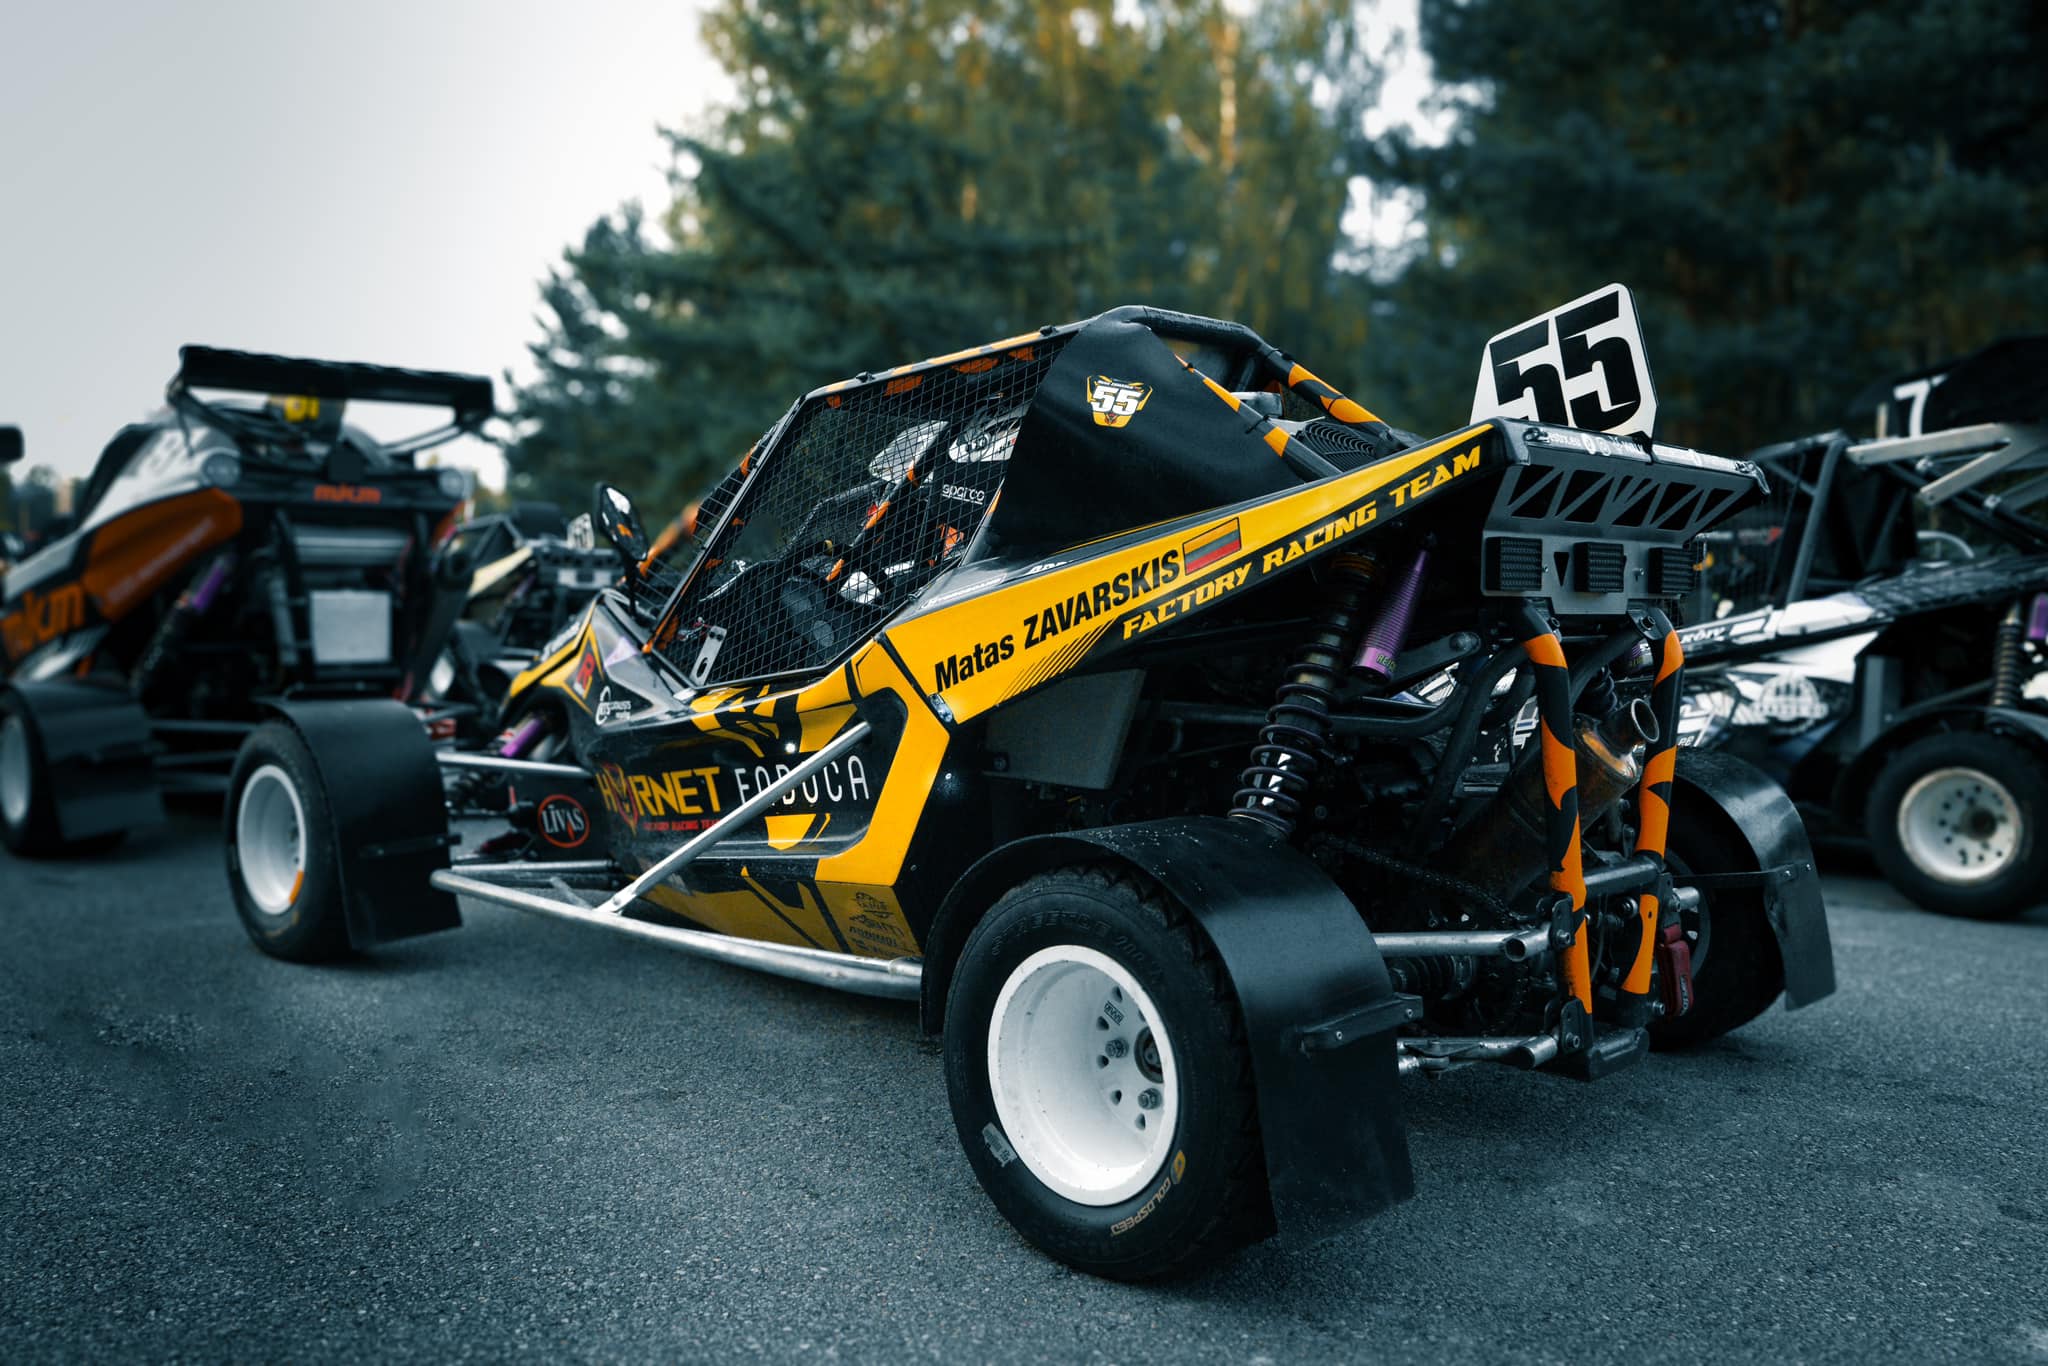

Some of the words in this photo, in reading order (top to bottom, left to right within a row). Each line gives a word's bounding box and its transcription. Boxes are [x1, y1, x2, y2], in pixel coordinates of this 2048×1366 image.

[1090, 386, 1143, 416] 55
[1489, 290, 1641, 432] 55
[942, 484, 985, 504] sparco
[1122, 563, 1252, 641] FACTORY
[1262, 500, 1377, 574] RACING
[1389, 445, 1481, 508] TEAM
[933, 634, 1015, 693] Matas
[1023, 549, 1180, 650] ZAVARSKIS
[1110, 1177, 1171, 1236] GOLDSPEED
